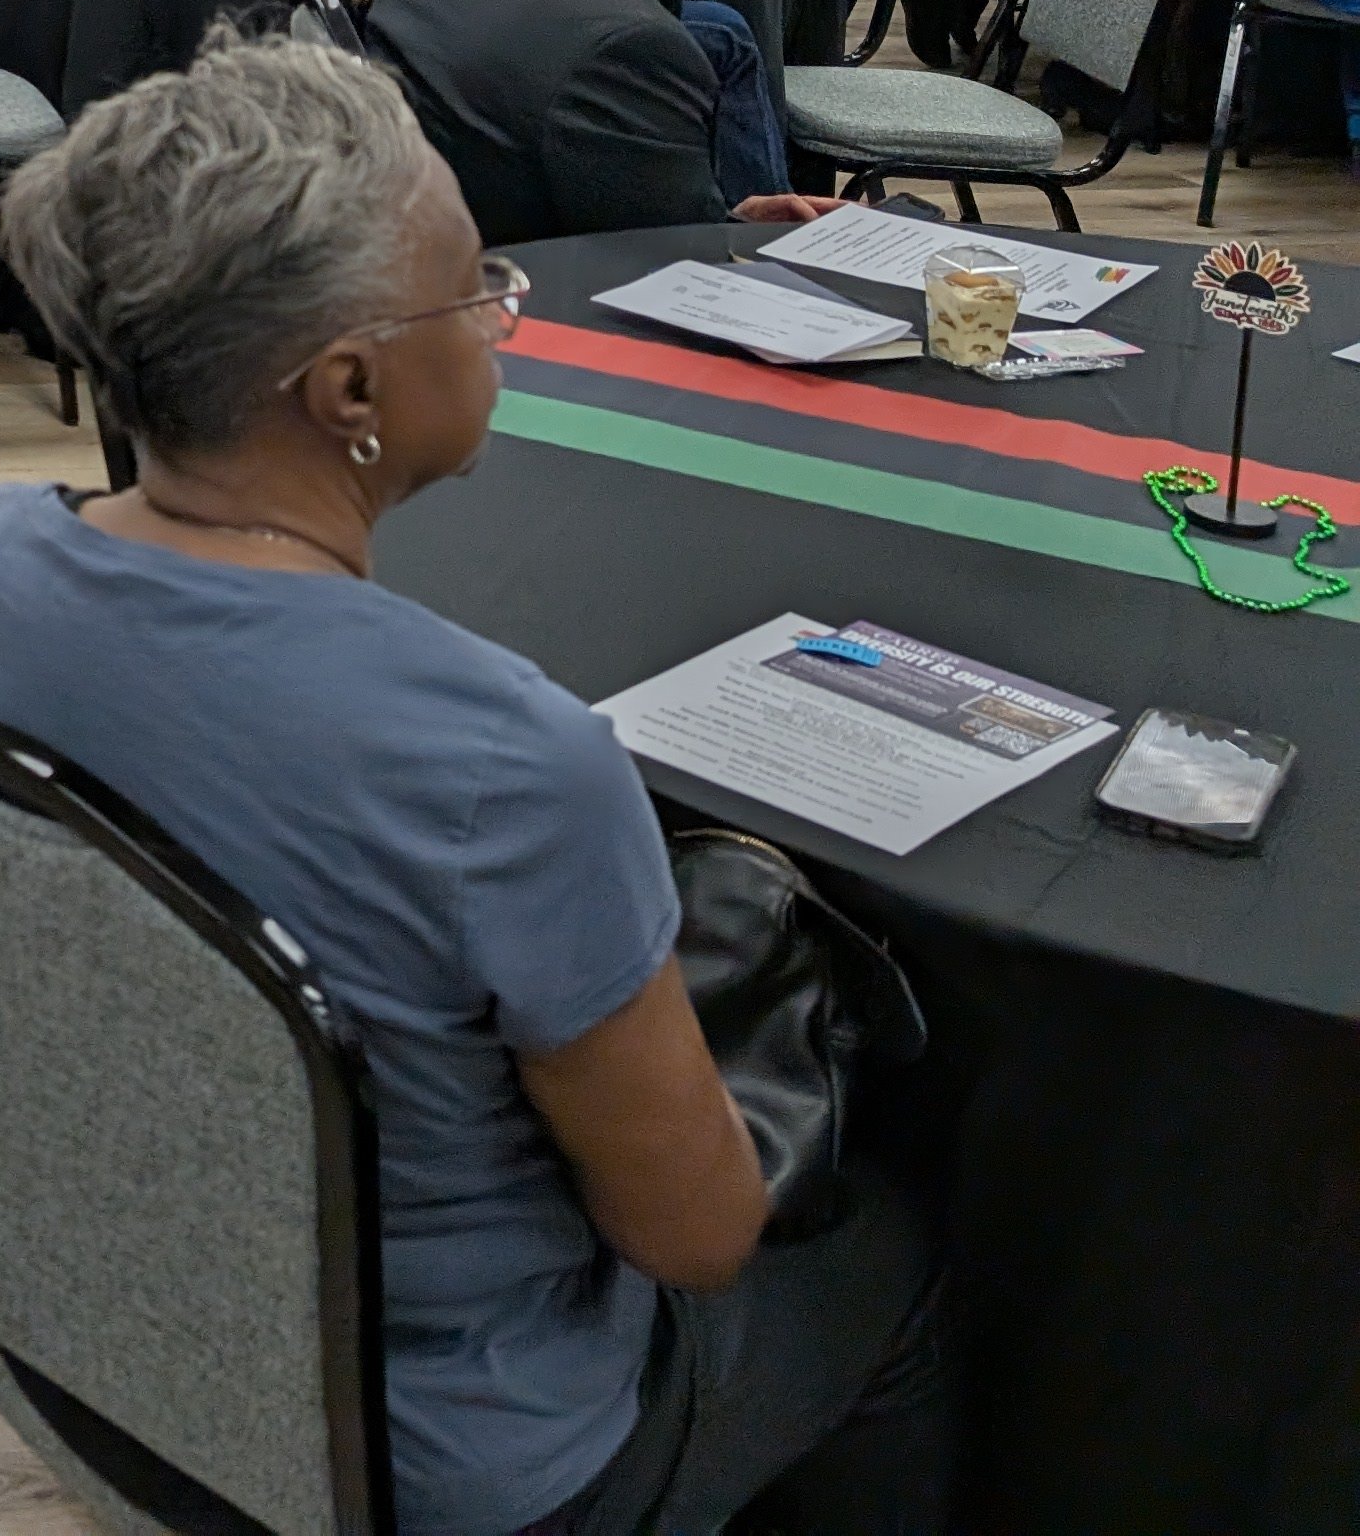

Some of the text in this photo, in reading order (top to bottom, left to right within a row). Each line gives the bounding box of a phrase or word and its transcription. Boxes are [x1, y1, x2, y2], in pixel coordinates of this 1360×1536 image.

[838, 629, 933, 667] DIVERSITY
[930, 663, 955, 677] IS
[953, 670, 996, 692] OUR
[992, 684, 1097, 727] STRENGTH
